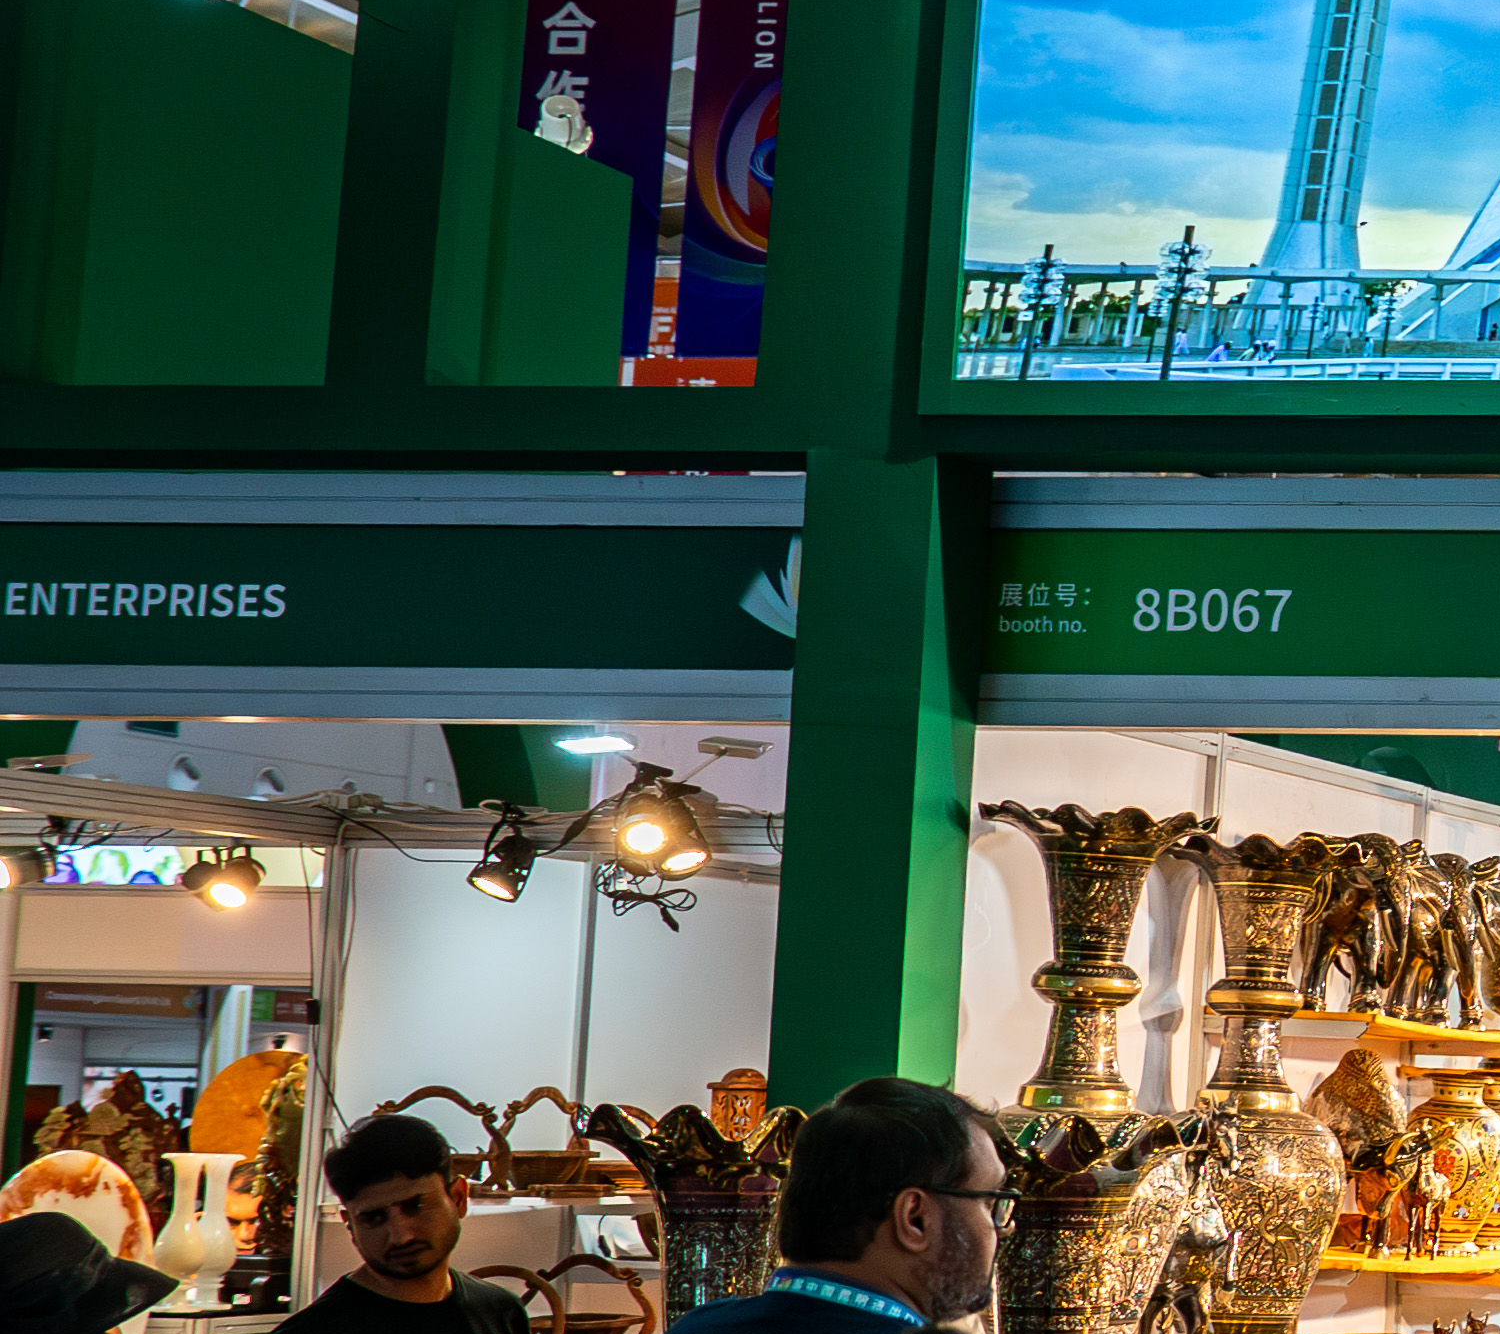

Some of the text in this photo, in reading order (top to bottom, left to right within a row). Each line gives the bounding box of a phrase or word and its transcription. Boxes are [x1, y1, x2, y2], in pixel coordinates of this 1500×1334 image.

[5, 581, 287, 618] ENTERPRISES
[1133, 588, 1293, 633] 8B067
[1000, 616, 1088, 634] booth no.
